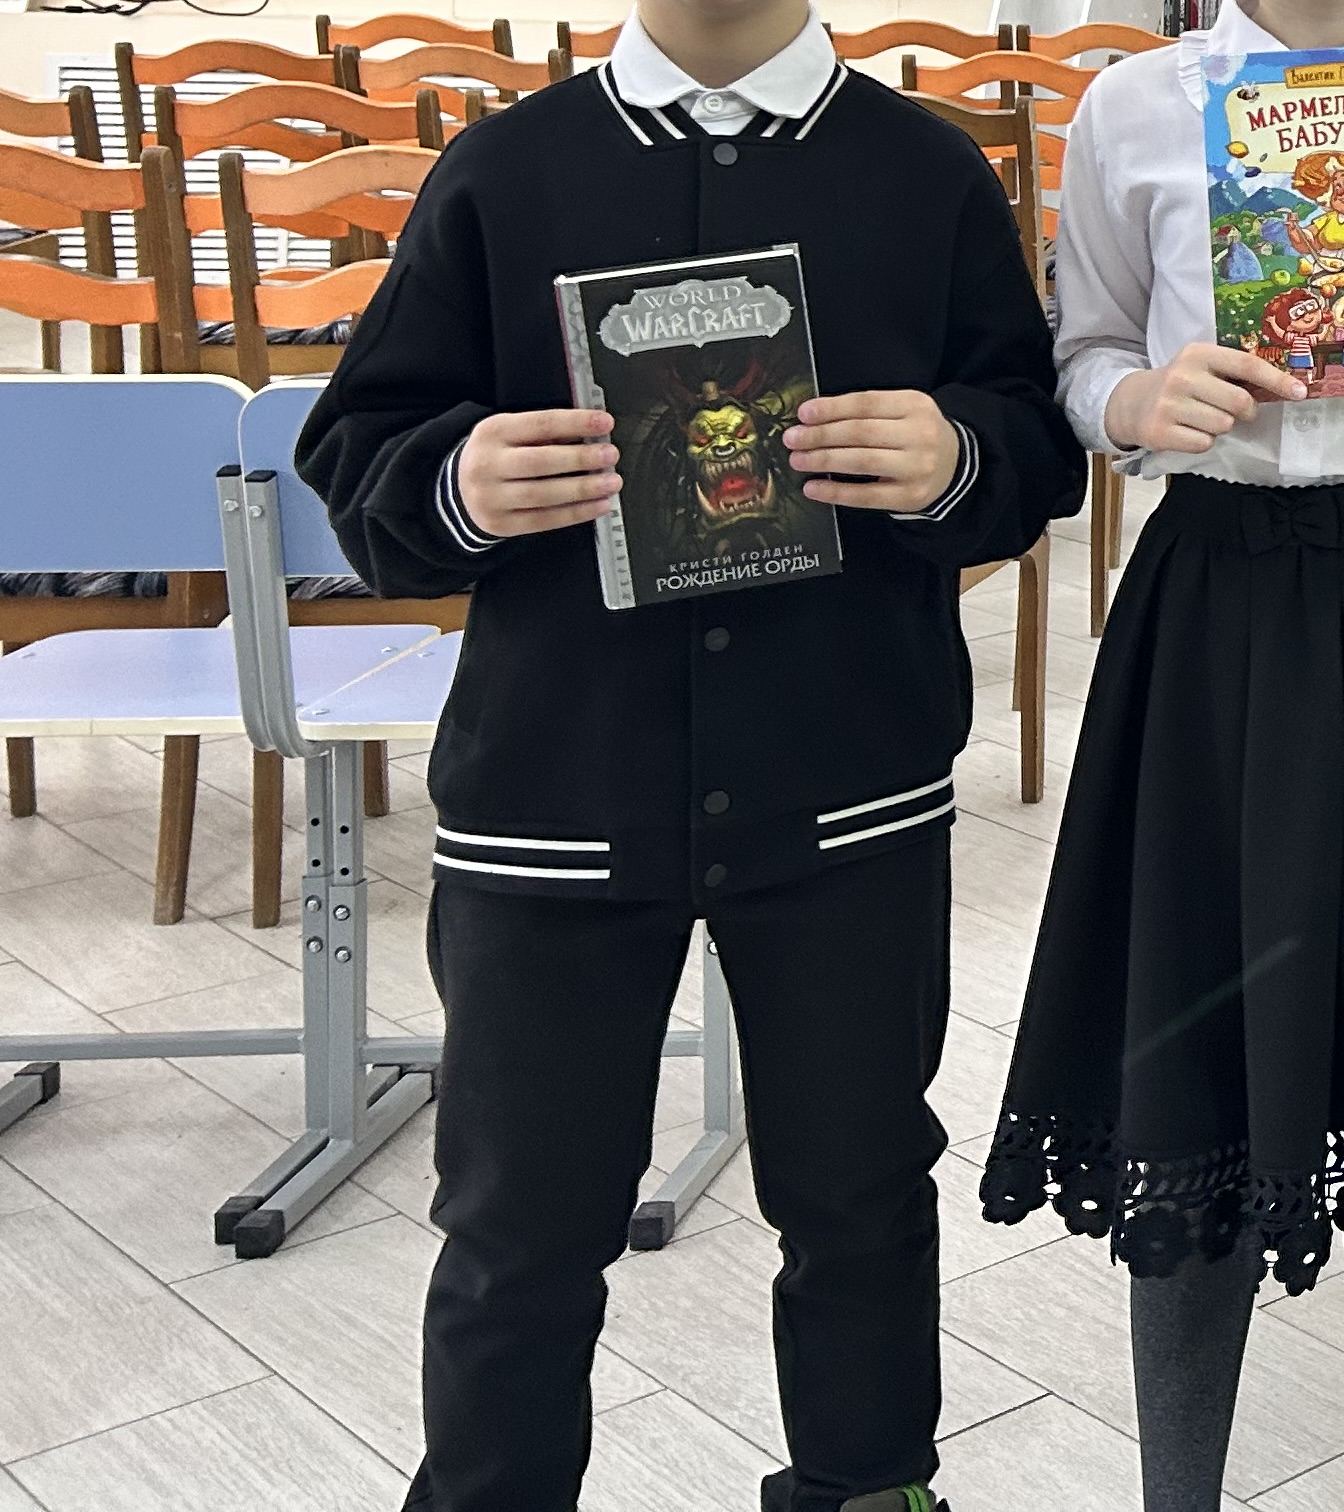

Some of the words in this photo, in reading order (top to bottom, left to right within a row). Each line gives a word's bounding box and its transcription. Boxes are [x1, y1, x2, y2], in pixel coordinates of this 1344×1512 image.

[643, 285, 742, 310] WORLD
[656, 562, 762, 593] РОЖДЕНИЕ
[764, 553, 821, 576] ОРДЫ
[668, 554, 733, 573] КРИСТИ
[740, 543, 804, 561] ГОЛДЕН
